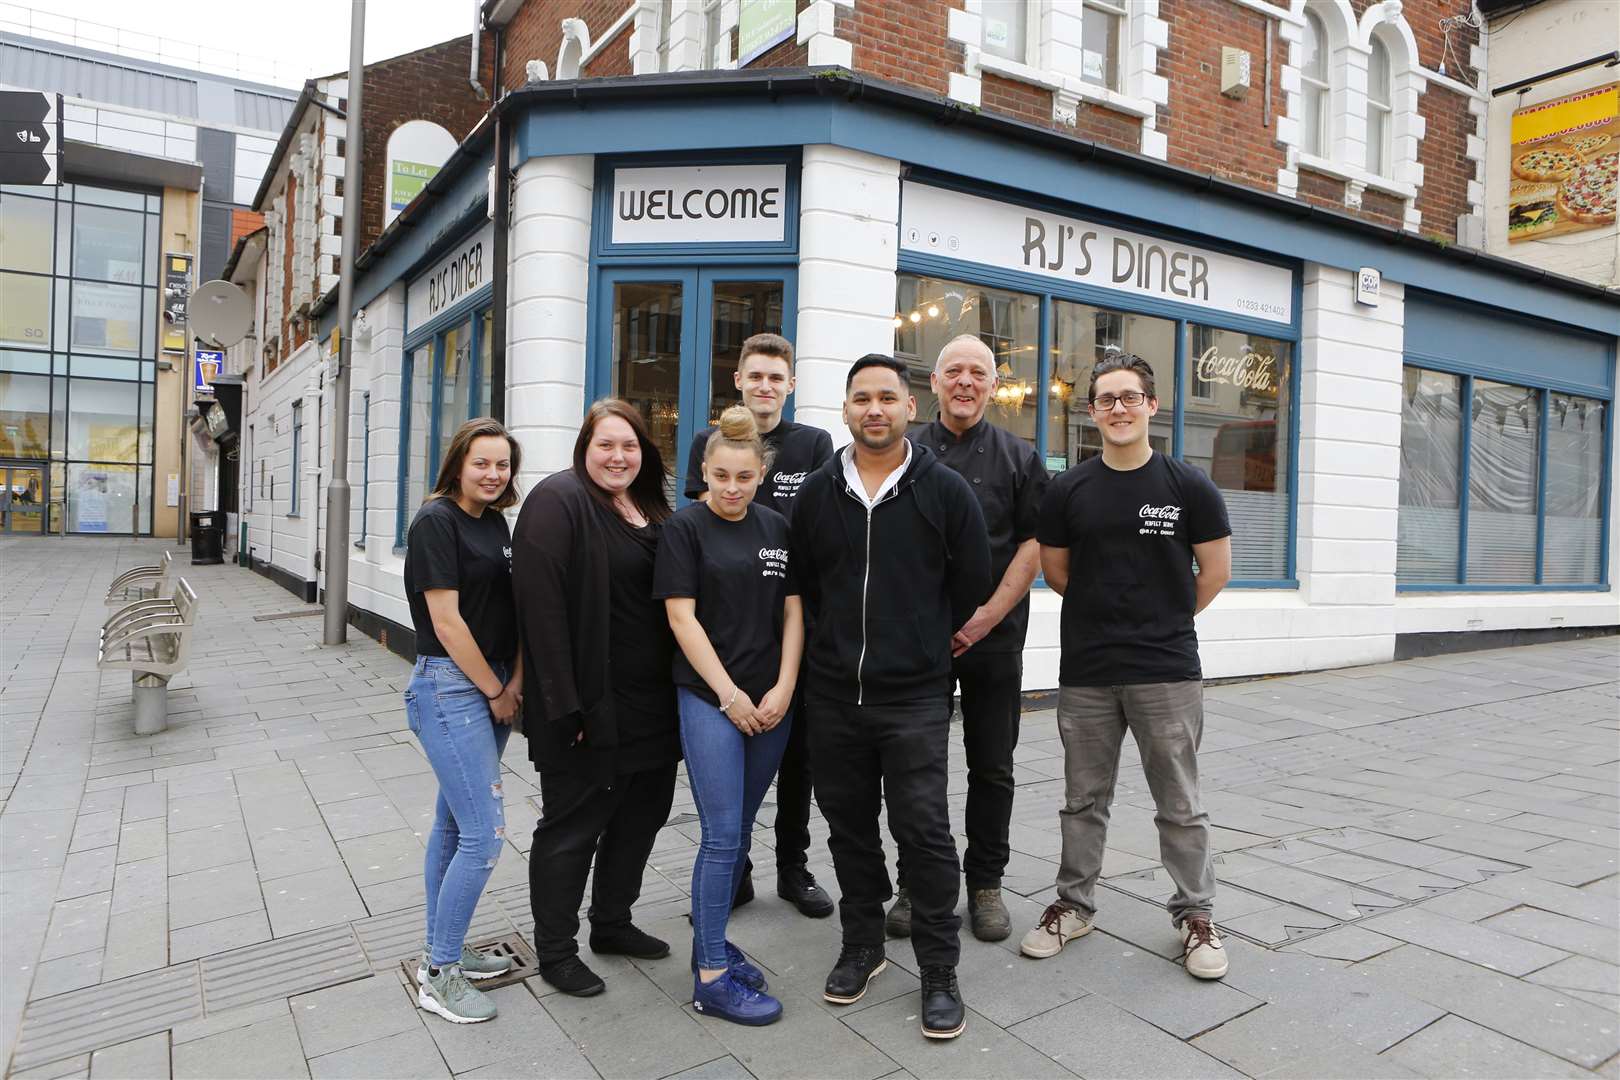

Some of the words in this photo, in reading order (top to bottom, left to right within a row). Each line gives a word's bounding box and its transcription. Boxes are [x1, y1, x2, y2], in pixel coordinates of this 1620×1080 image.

[619, 188, 779, 221] WELCOME
[450, 242, 482, 302] DINER
[1022, 217, 1097, 276] RJ'S
[1111, 237, 1209, 301] DINER
[1138, 503, 1182, 521] Coca-Cola
